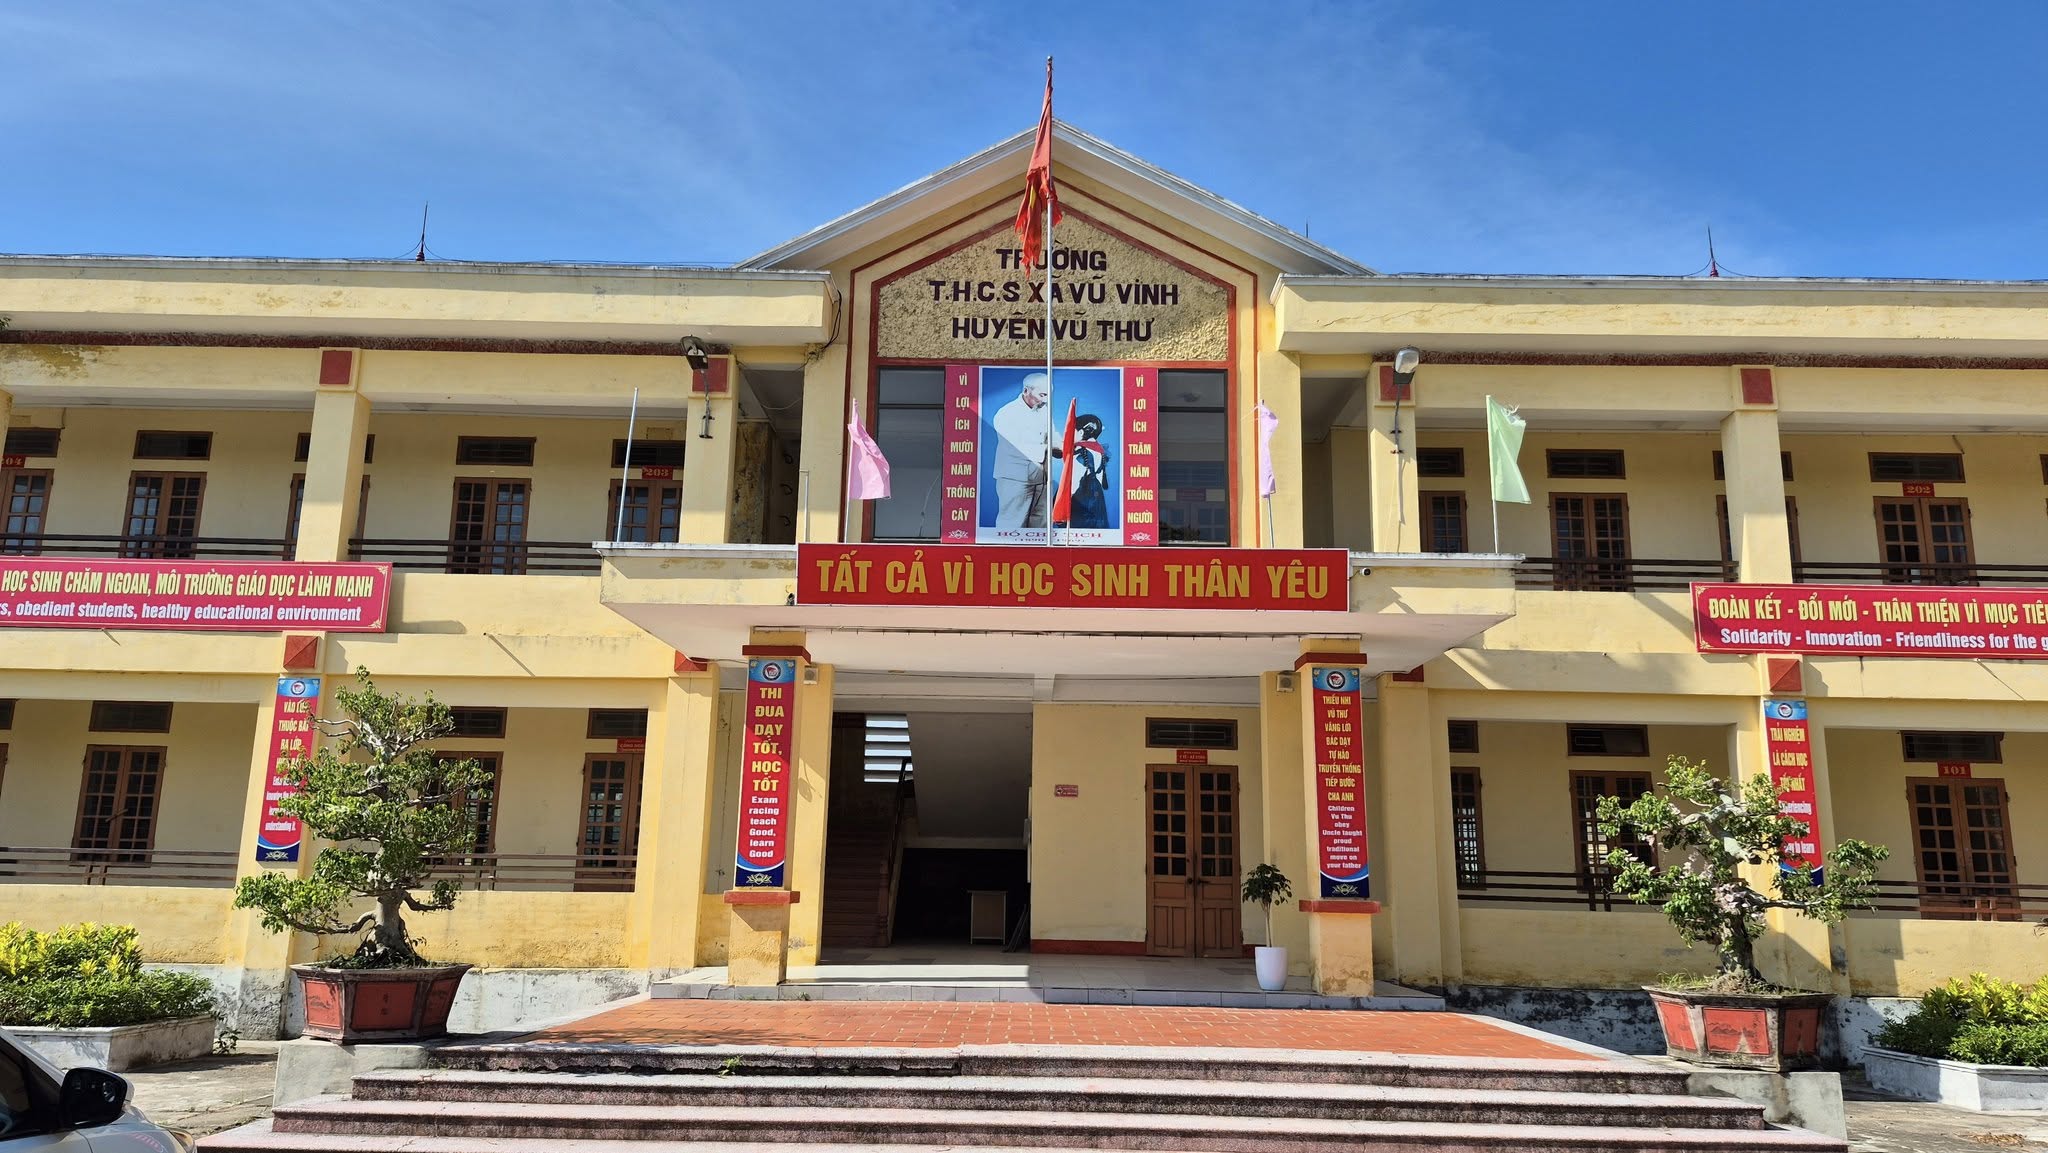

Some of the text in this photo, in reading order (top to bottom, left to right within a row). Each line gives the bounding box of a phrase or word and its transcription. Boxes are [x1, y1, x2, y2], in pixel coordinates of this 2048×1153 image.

[929, 280, 1020, 302] T.H.C.S
[1069, 275, 1106, 304] VŨ
[952, 312, 1155, 345] HUYỆN VŨ THƯ
[958, 373, 967, 386] VÌ
[1136, 375, 1145, 388] VÌ
[956, 396, 970, 411] LỢI
[1133, 398, 1147, 413] LỢI
[955, 417, 970, 430] ÍCH
[1133, 419, 1147, 432] ÍCH
[951, 440, 973, 453] MƯỜI
[1128, 442, 1152, 455] TRĂM
[951, 463, 972, 476] NĂM
[1130, 465, 1150, 478] NĂM
[1907, 486, 1931, 494] 202
[951, 508, 969, 521] CÂY
[1127, 509, 1153, 523] NGƯỜI
[816, 550, 1328, 602] TẤT CẢ VÌ HỌC SINH THÂN YÊU
[1, 568, 374, 602] HỌC SINH CHĂM NGOAN, MÔI TRƯỜNG GIÁO DỤC LÀNH MẠNH
[16, 601, 75, 616] obedient
[78, 602, 138, 619] students,
[141, 603, 191, 620] healthy
[194, 604, 273, 620] educational
[276, 605, 361, 621] environment
[1709, 594, 1750, 619] ĐOÀN
[1755, 592, 1782, 620] KẾT
[1798, 592, 1824, 620] ĐỔI
[1828, 595, 1857, 621] MỚI
[1873, 597, 1913, 622] THÂN
[1917, 598, 1960, 627] THIỆN
[1964, 599, 1980, 623] VÌ
[1984, 603, 2018, 628] MỤC
[2022, 599, 2048, 625] TIÊ
[1720, 628, 1791, 646] Solidarity
[1805, 630, 1882, 646] Innovation
[1896, 631, 1986, 648] Friendliness
[1989, 633, 2010, 648] for
[2013, 634, 2037, 649] the
[760, 688, 782, 699] THI
[755, 706, 784, 717] ĐUA
[1336, 709, 1348, 718] THƯ
[279, 718, 297, 734] THUỘC
[754, 724, 783, 738] DẠY
[753, 738, 782, 755] TỐT,
[1326, 735, 1351, 747] BÁC DẠY
[1329, 749, 1350, 761] TỰ HÀO
[1773, 749, 1808, 769] LÀ CÁCH HỌC
[752, 761, 781, 775] HỌC
[1943, 766, 1966, 775] 101
[752, 775, 779, 791] TỐT
[1325, 776, 1355, 787] TIẾP BƯỚC
[751, 796, 778, 804] Exam
[1328, 792, 1354, 801] CHA ANH
[749, 807, 779, 815] racing
[750, 817, 777, 825] teach
[749, 839, 775, 847] learn
[749, 850, 774, 858] Good
